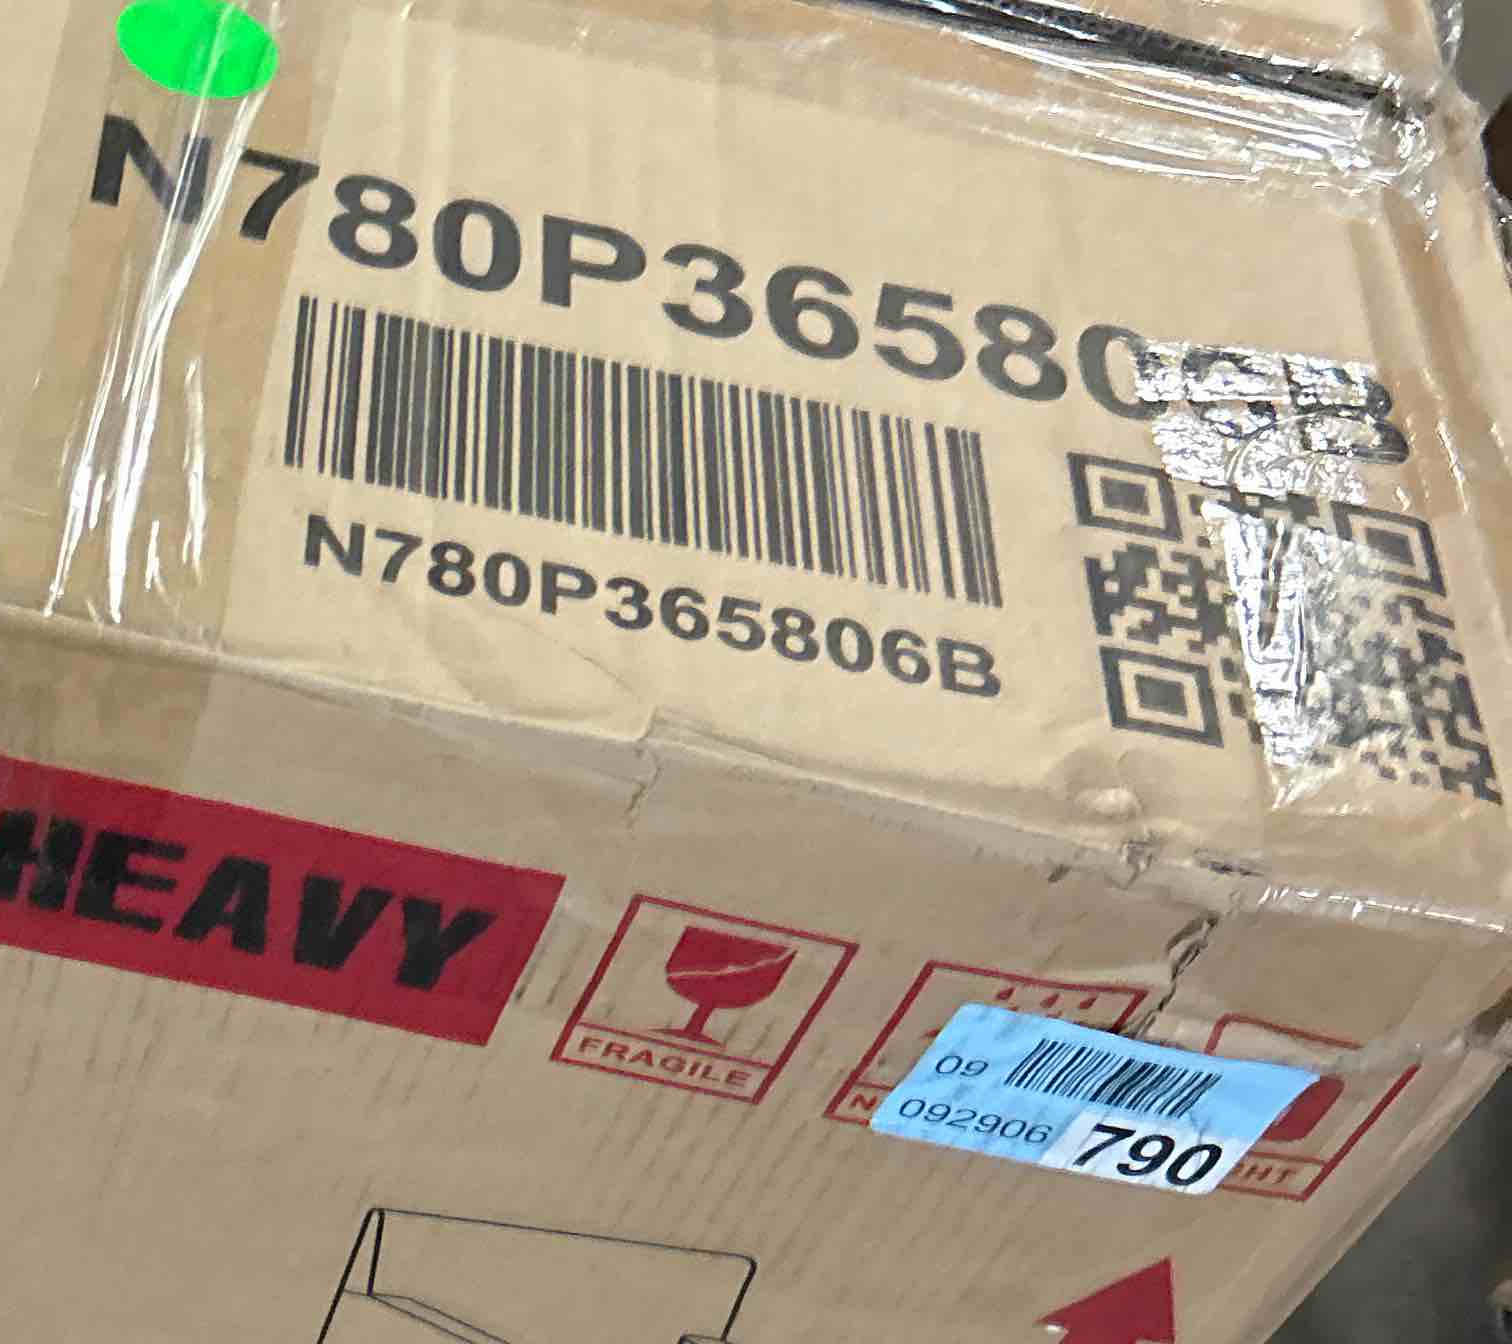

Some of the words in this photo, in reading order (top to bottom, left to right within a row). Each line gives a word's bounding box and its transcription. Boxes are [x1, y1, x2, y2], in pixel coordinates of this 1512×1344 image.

[303, 512, 1003, 701] N780P365806B
[577, 1036, 753, 1088] FRAGILE
[934, 1053, 989, 1079] 09
[898, 1096, 1054, 1146] 092906
[1070, 1123, 1224, 1188] 790
